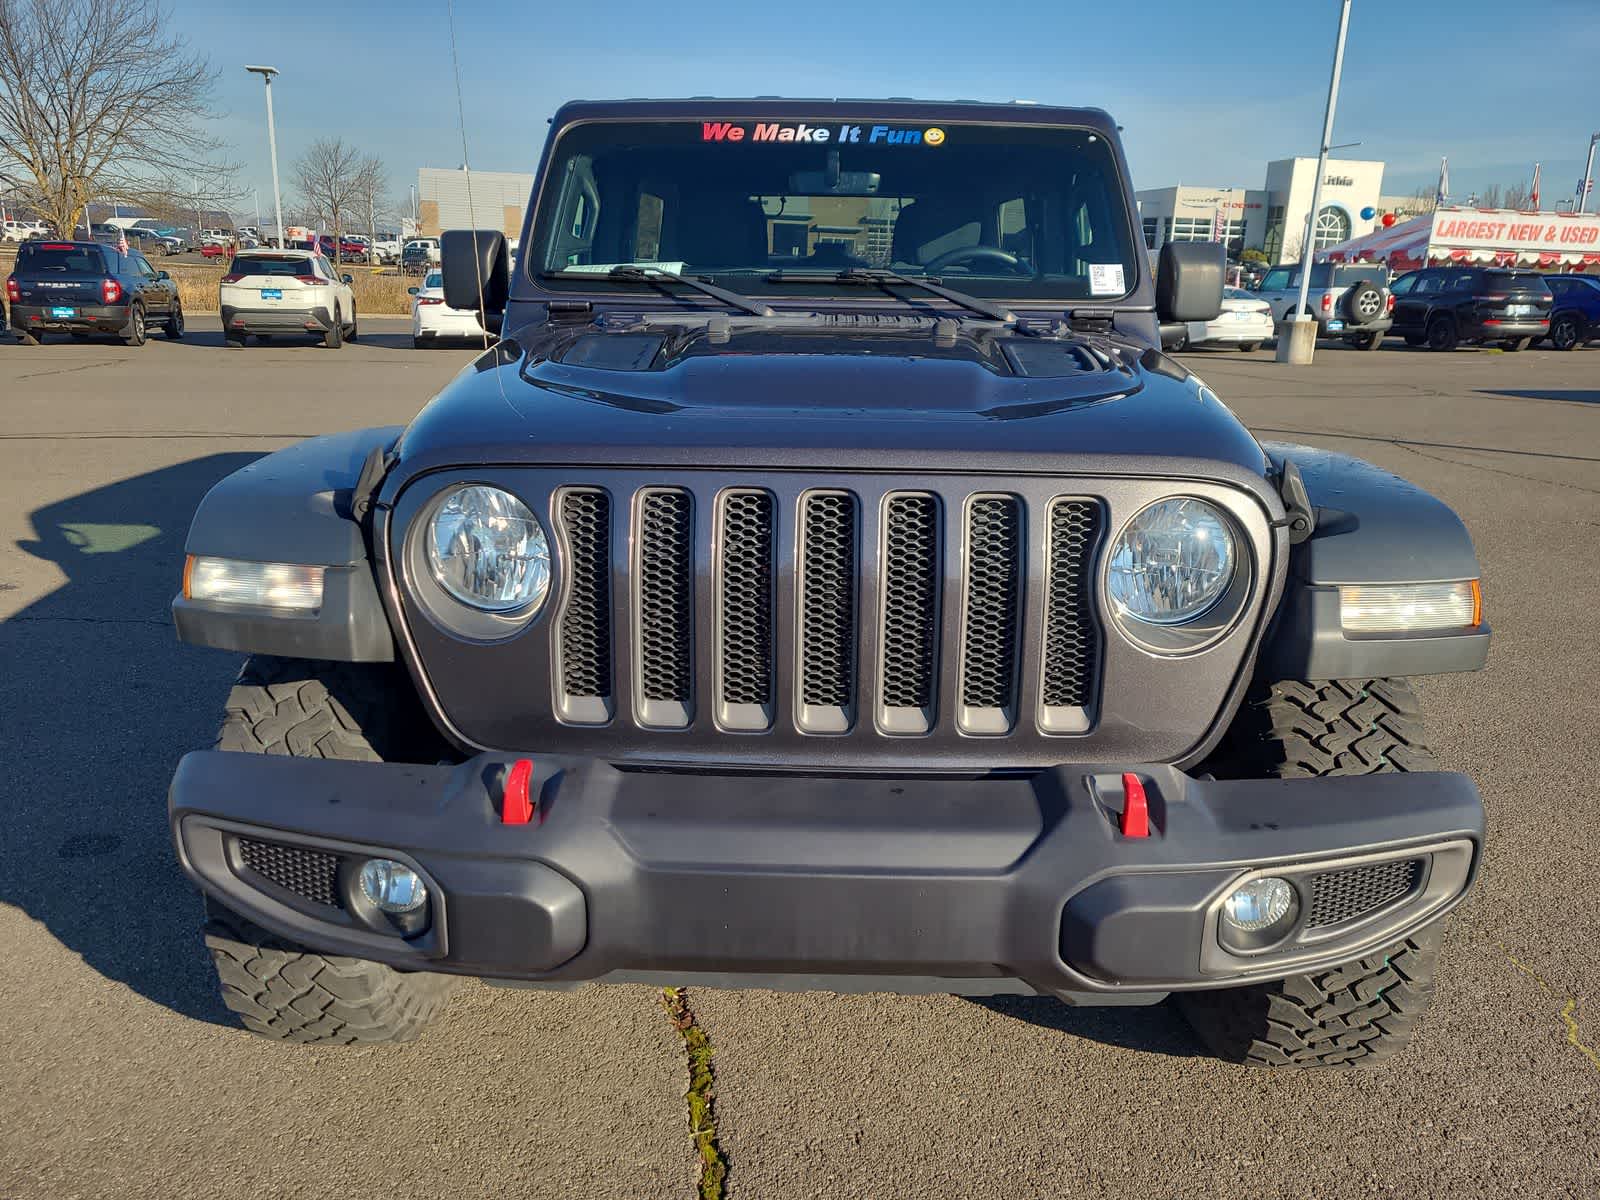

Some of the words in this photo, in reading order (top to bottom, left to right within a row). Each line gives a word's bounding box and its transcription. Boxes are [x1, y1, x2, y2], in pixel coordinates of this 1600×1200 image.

[703, 122, 745, 142] We
[752, 123, 831, 143] Make
[838, 125, 862, 143] It
[868, 126, 922, 144] Fun
[1436, 220, 1506, 241] LARGEST
[1507, 223, 1544, 242] NEW
[1544, 226, 1556, 242] &
[1560, 225, 1600, 244] USED
